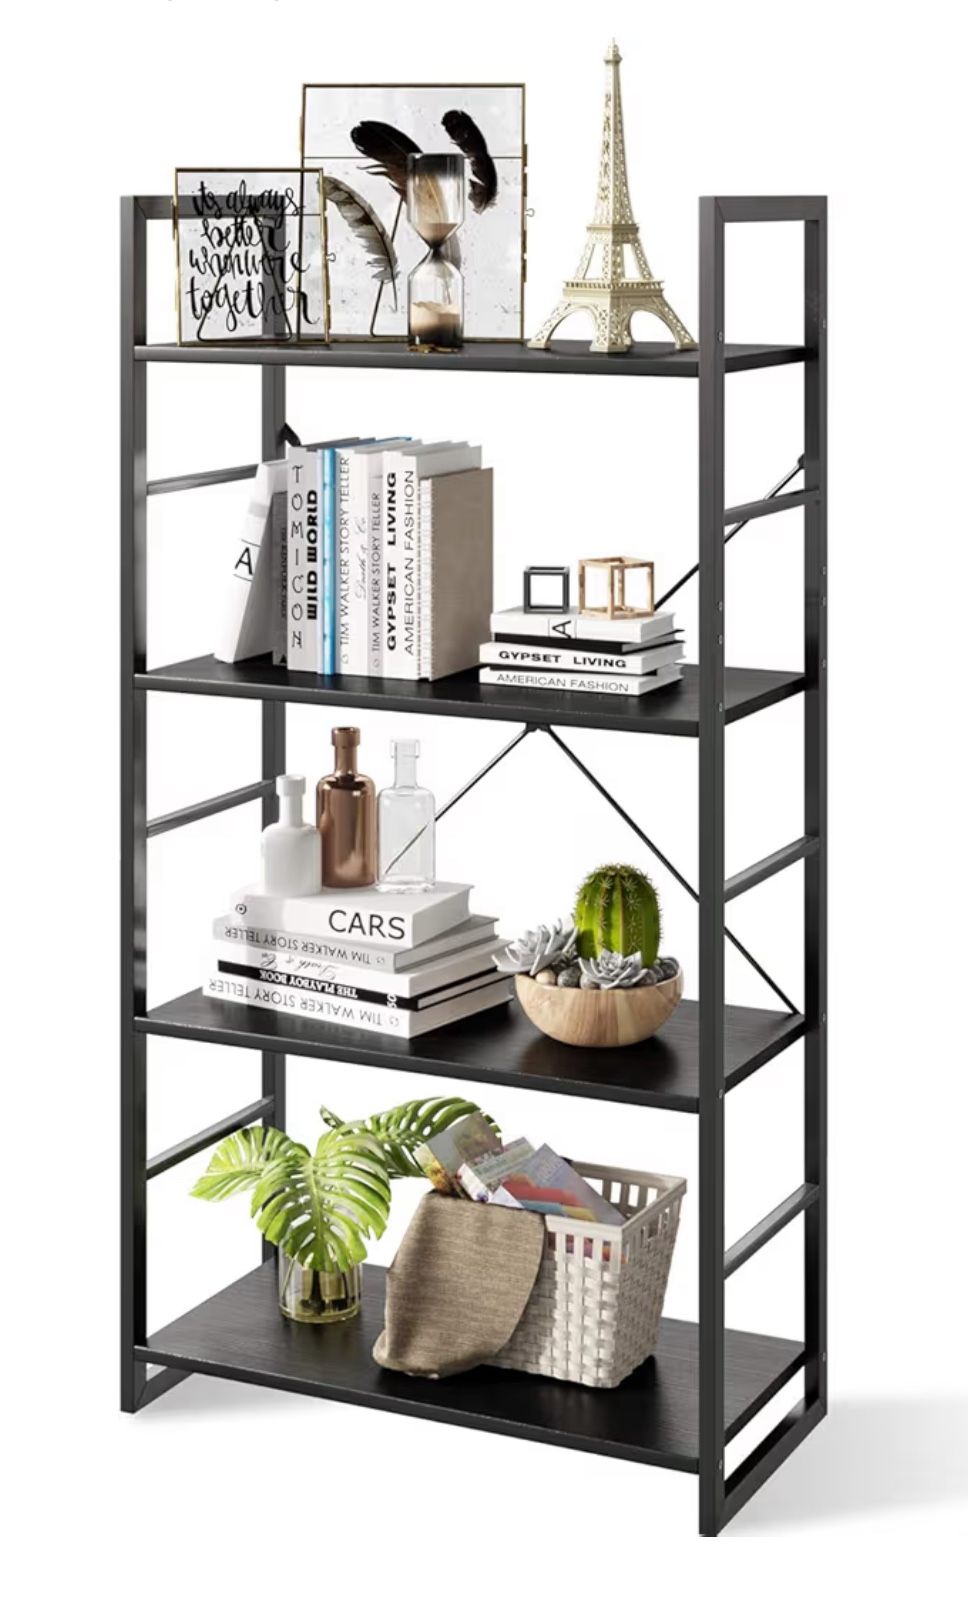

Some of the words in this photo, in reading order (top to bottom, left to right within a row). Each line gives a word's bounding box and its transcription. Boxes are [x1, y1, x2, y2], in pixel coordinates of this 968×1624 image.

[226, 179, 303, 229] always
[201, 216, 291, 252] better
[186, 276, 320, 332] together
[339, 457, 350, 504] TELLER
[372, 492, 381, 533] TELLER
[386, 472, 397, 546] LIVING
[404, 470, 414, 551] FASHION
[307, 489, 318, 563] WORLD
[340, 508, 350, 555] STORY
[234, 547, 254, 576] A
[372, 536, 381, 575] STORY
[307, 570, 318, 620] WILD
[340, 558, 350, 617] WALKER
[372, 578, 381, 629] WALKER
[386, 562, 397, 651] GYPSET
[404, 557, 414, 656] AMERICAN
[340, 622, 350, 646] TIM
[372, 631, 381, 652] TIM
[551, 620, 572, 639] A
[498, 650, 562, 664] GYPSET
[573, 653, 627, 668] LIVING
[496, 674, 566, 688] AMERICAN
[570, 679, 629, 692] FASHION
[224, 926, 260, 944] TELLER
[328, 909, 406, 940] CARS
[263, 933, 298, 951] STORY
[301, 941, 348, 961] WALKER
[351, 950, 371, 964] TIM
[208, 979, 250, 999] TELLER
[259, 970, 287, 985] BOOK
[287, 976, 335, 995] PLAYBOY
[336, 984, 358, 999] THE
[253, 987, 295, 1008] STORY
[300, 998, 355, 1020] WALKER
[359, 1010, 382, 1026] TIM
